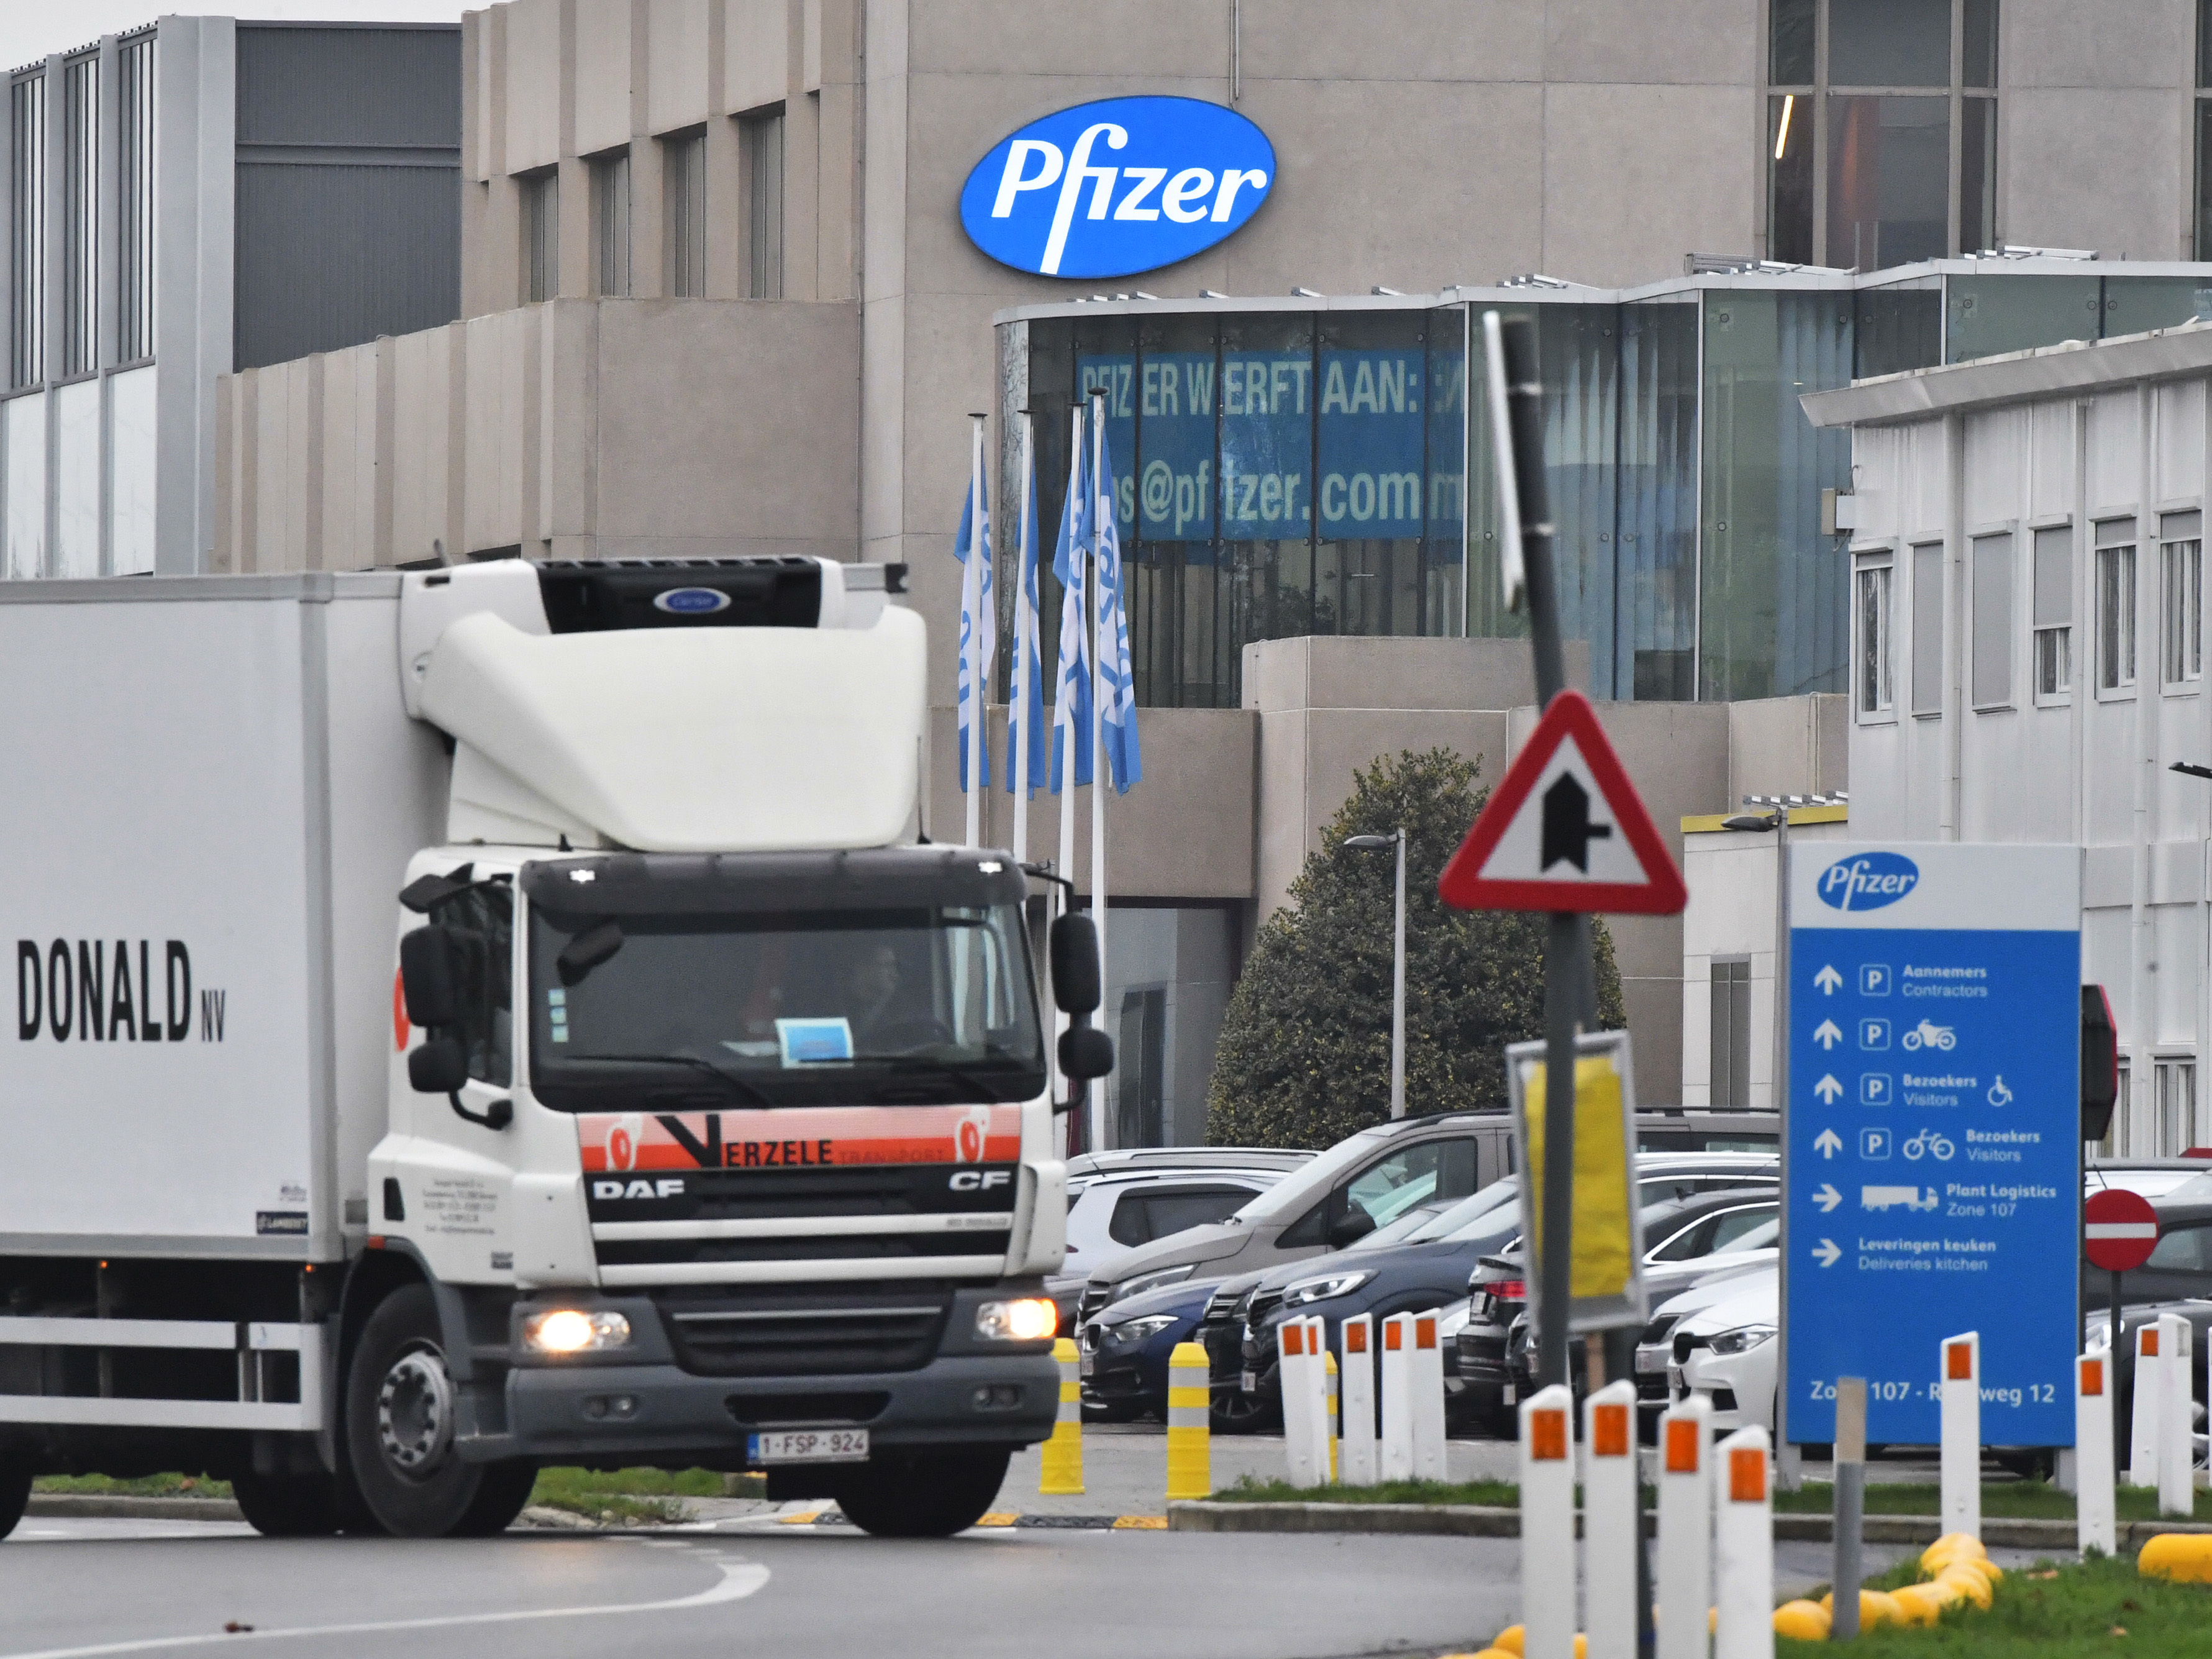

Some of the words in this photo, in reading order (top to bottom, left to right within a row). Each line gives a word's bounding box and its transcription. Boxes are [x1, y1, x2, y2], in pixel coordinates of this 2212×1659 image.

[991, 122, 1267, 275] Pfizer
[1321, 360, 1417, 414] AAN:
[1826, 860, 1915, 912] Pfizer
[1903, 964, 1987, 978] Aannemers
[17, 938, 192, 1043] DONALD
[201, 990, 225, 1043] NV
[1903, 983, 1988, 997] Contractors
[1903, 1074, 1977, 1087] Bezoekers
[1903, 1092, 1959, 1107] Visitors
[655, 1113, 833, 1167] VERZELE
[1966, 1130, 2041, 1144] Bezoekers
[1967, 1148, 2021, 1162] Visitors
[949, 1171, 1011, 1191] CF
[593, 1179, 685, 1200] DAF
[1946, 1184, 1987, 1198] Plant
[1990, 1184, 2056, 1200] Logistics
[1946, 1203, 1986, 1216] Zone
[1990, 1203, 2017, 1217] 107
[1859, 1238, 1939, 1253] Leveringen
[1944, 1238, 1996, 1252] keuken
[1859, 1256, 1931, 1271] Deliveries
[1935, 1258, 1988, 1271] kitchen
[1810, 1381, 1837, 1399] Zo
[1871, 1381, 1911, 1401] 107
[2029, 1384, 2055, 1403] 12
